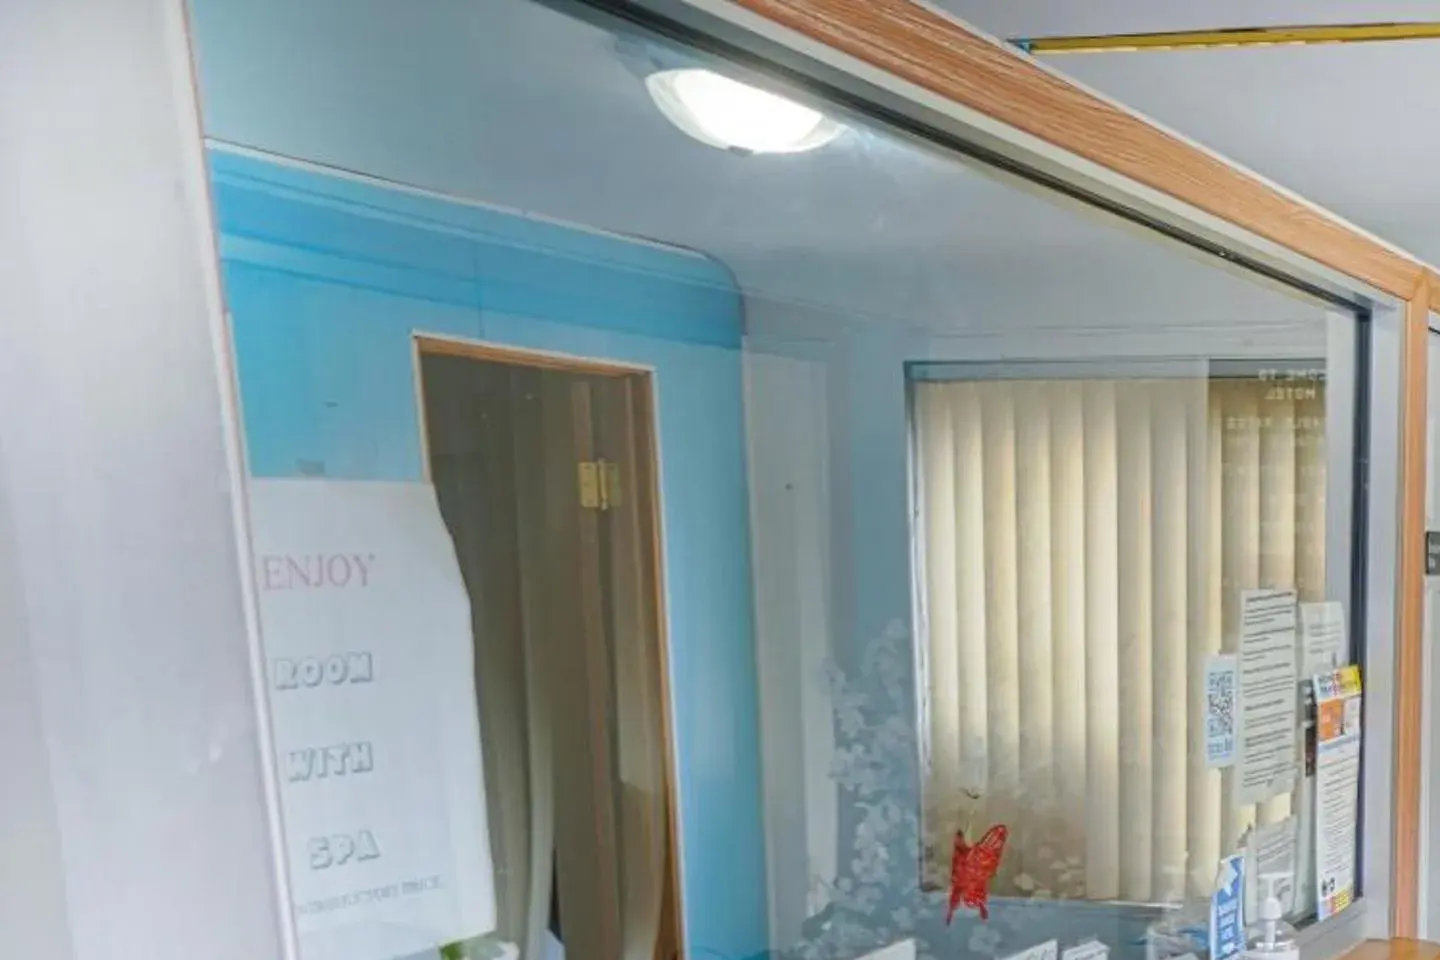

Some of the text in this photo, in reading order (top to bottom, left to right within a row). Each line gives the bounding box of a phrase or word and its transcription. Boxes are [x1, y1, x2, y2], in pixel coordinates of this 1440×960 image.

[261, 553, 377, 592] ENJOY
[274, 650, 376, 691] ROOM
[287, 741, 375, 783] WITH
[307, 829, 381, 870] SPA
